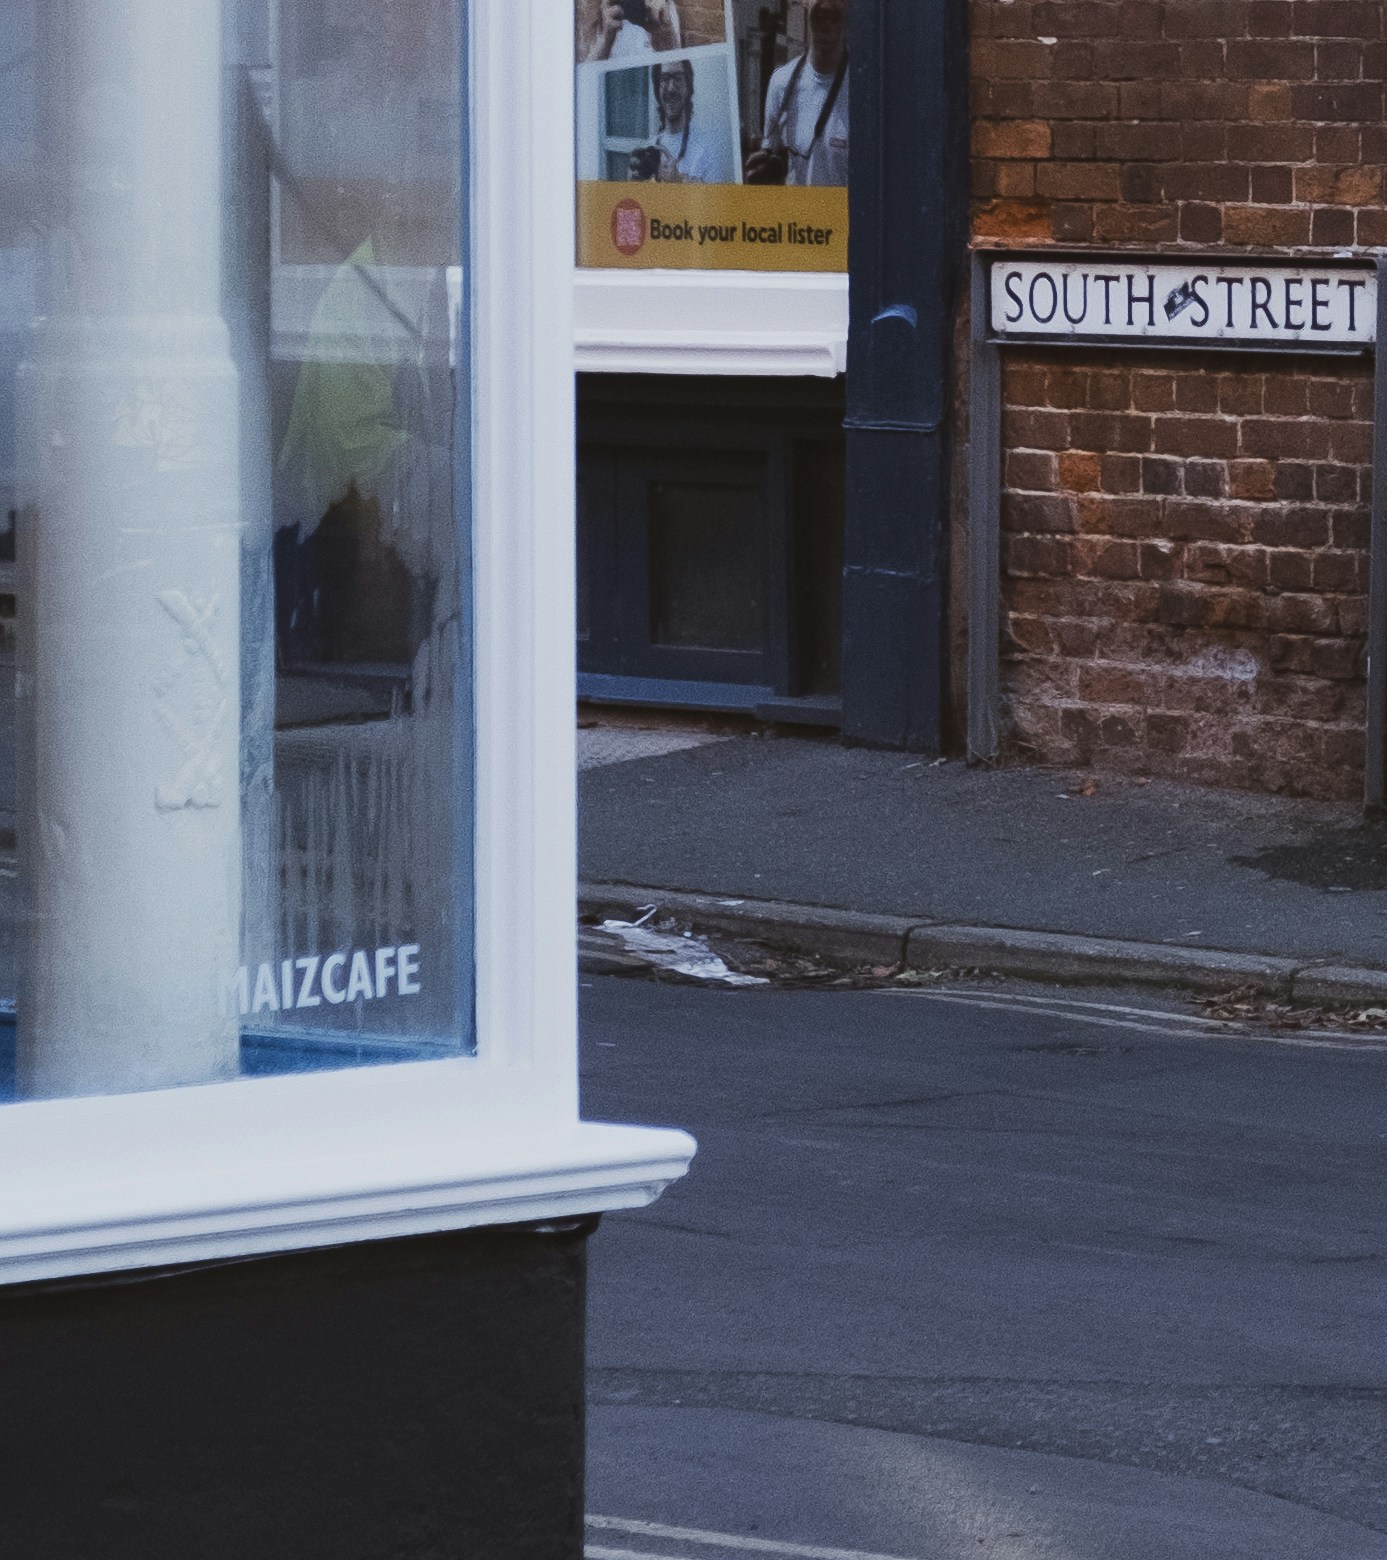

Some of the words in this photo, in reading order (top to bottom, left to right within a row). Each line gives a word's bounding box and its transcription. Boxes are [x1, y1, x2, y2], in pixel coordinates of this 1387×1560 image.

[649, 218, 694, 241] Book
[698, 225, 737, 245] your
[741, 221, 782, 244] local
[787, 222, 833, 245] lister
[1004, 271, 1156, 326] SOUTH
[1190, 275, 1366, 332] STREET
